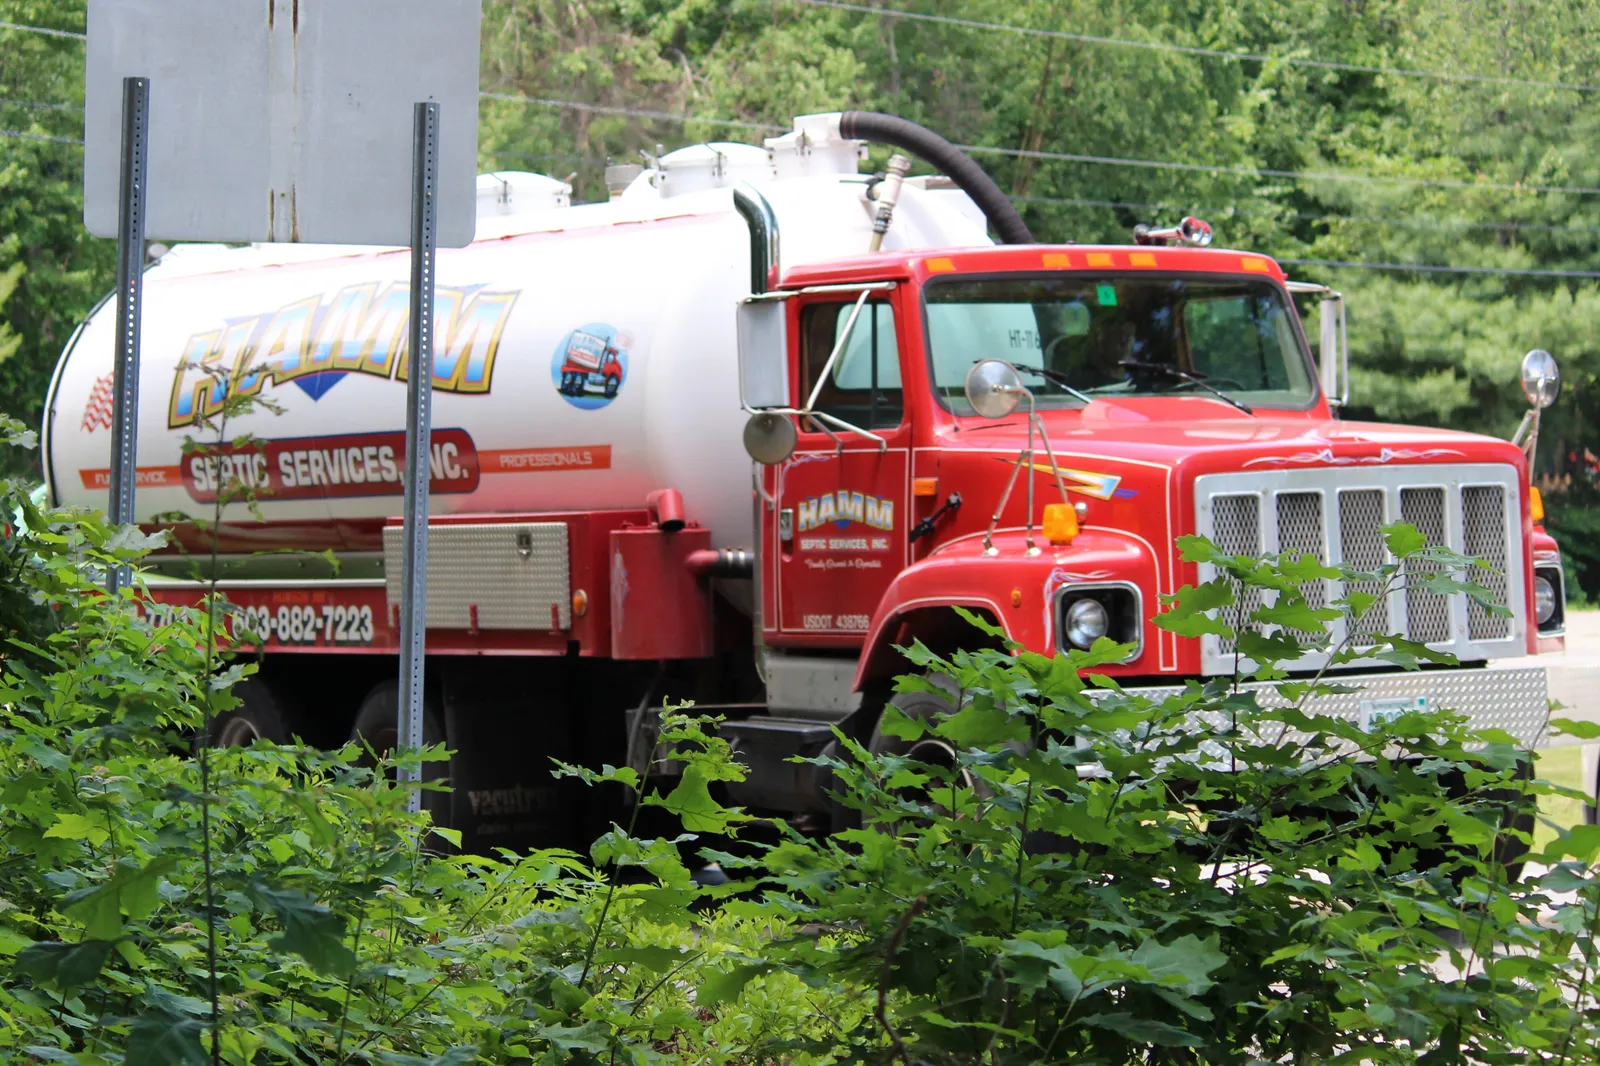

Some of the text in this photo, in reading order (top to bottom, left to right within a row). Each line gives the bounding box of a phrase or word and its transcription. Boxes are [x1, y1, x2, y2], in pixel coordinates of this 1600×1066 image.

[168, 281, 522, 430] HAMM
[191, 442, 469, 492] SEPTIC SERVICES, NC.
[500, 451, 592, 468] PROFESSIONALS
[798, 490, 893, 531] HAMM
[802, 538, 888, 550] SEPTIC SERVICES, INC.
[232, 604, 374, 642] 603-882-7223
[803, 615, 832, 630] USDOT
